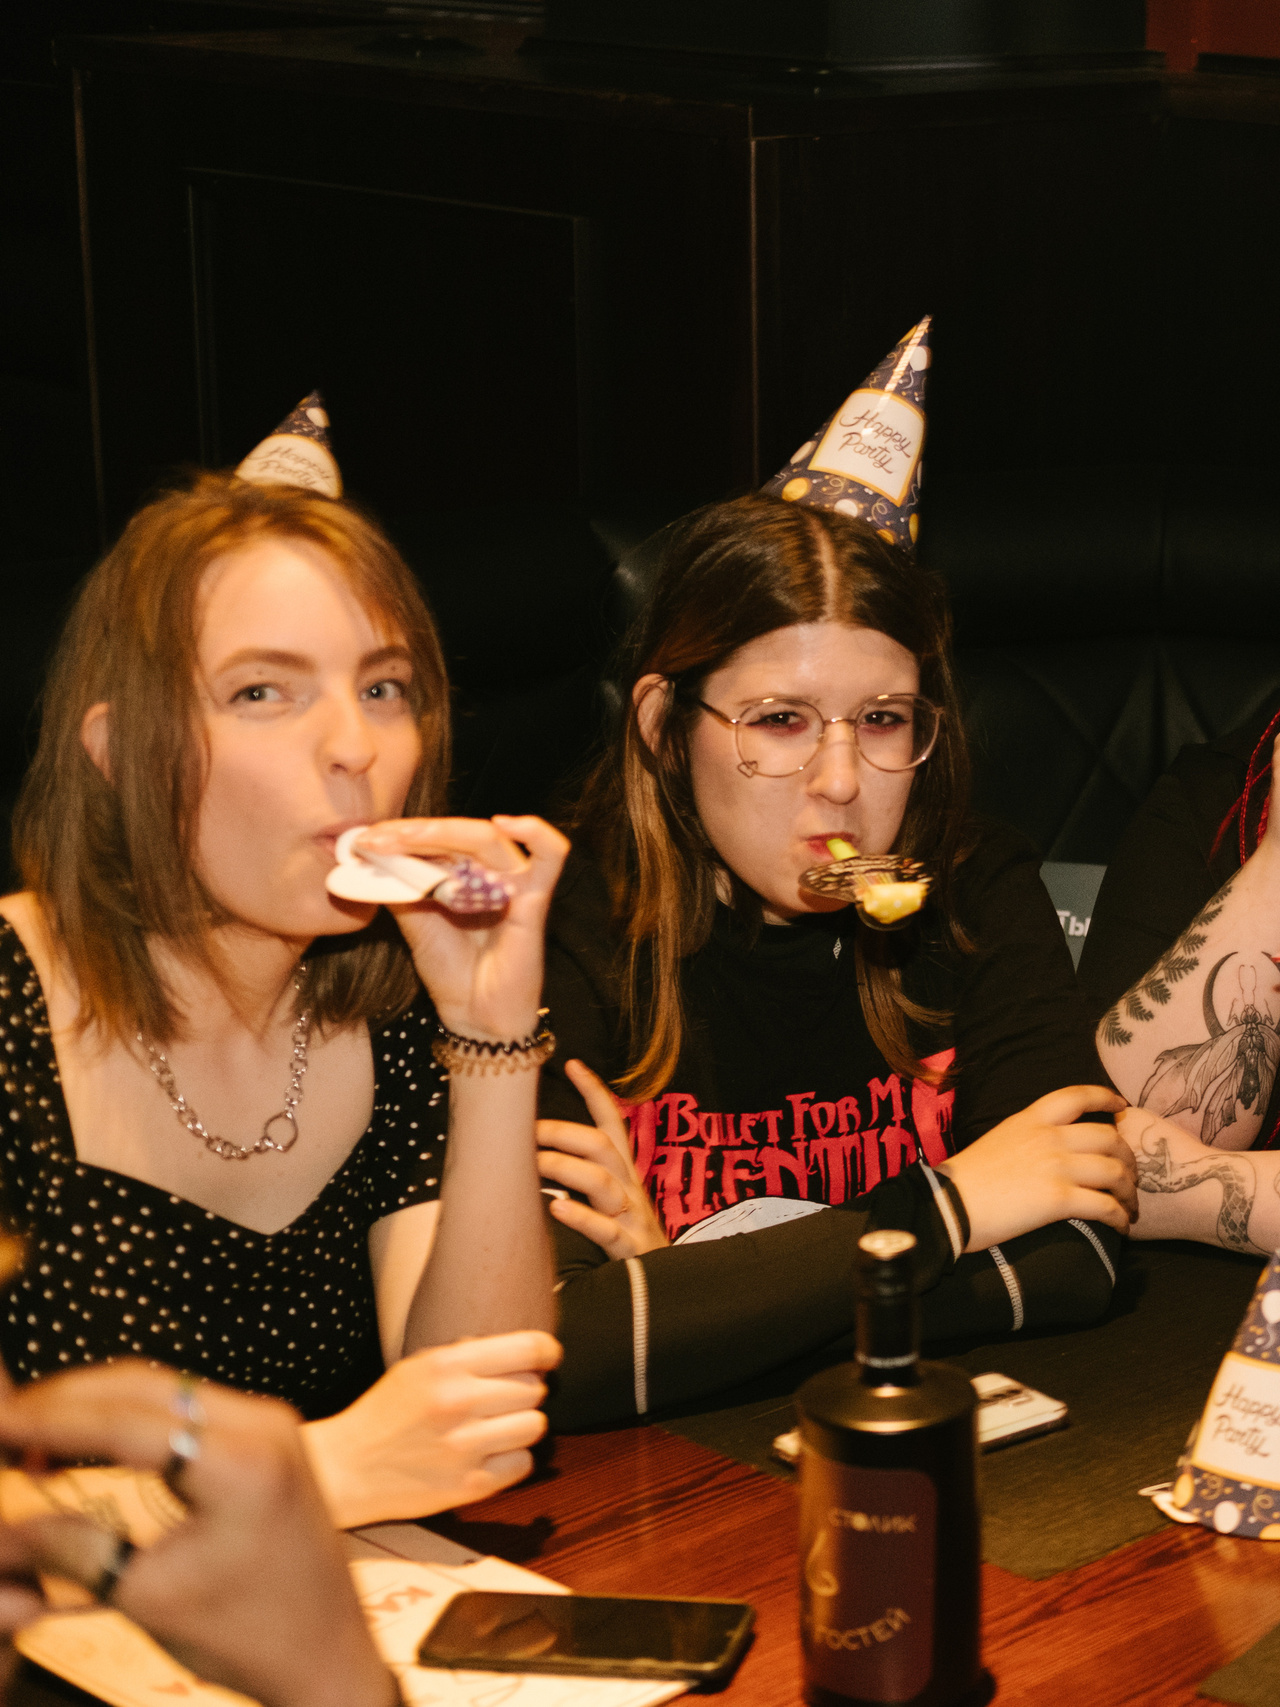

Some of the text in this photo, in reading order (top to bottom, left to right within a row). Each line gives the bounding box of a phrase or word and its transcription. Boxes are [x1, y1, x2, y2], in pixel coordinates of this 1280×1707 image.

[838, 432, 894, 474] Party
[839, 409, 912, 458] Happy
[785, 1091, 862, 1141] FOR
[867, 1073, 908, 1128] M
[1211, 1414, 1271, 1459] Party
